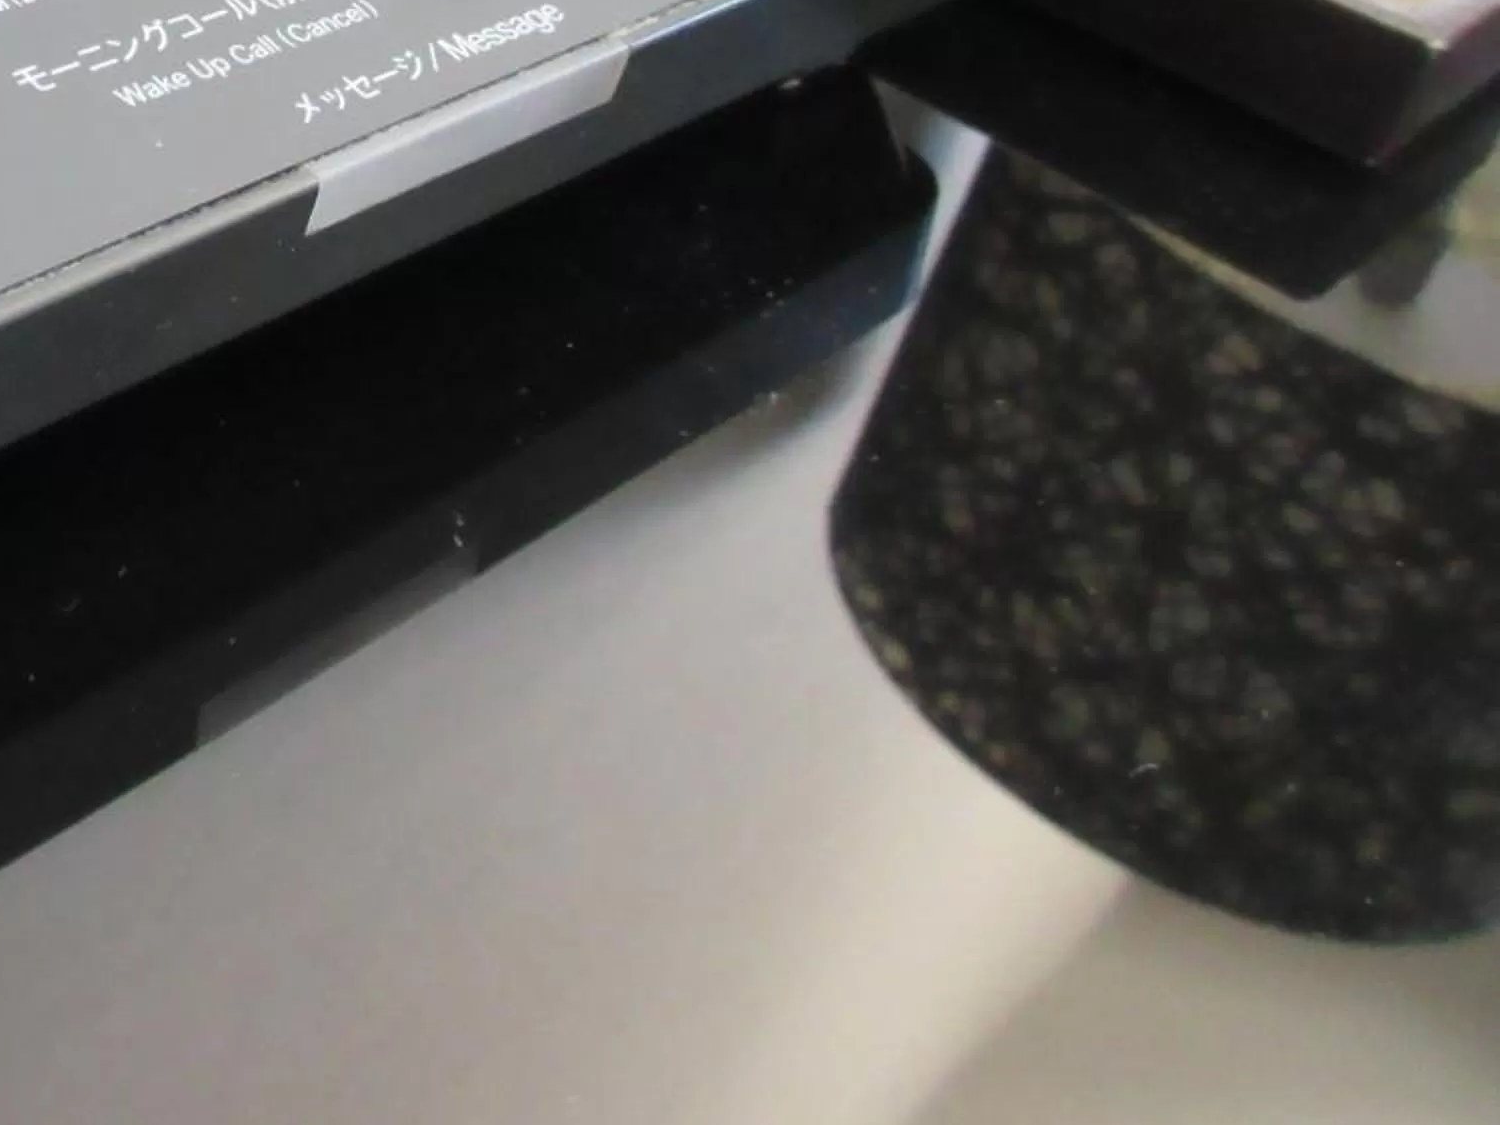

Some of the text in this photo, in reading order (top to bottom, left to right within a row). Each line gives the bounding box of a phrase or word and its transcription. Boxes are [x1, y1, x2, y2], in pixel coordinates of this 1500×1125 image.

[112, 71, 192, 108] Wake
[186, 56, 233, 80] Up
[228, 34, 283, 65] Call
